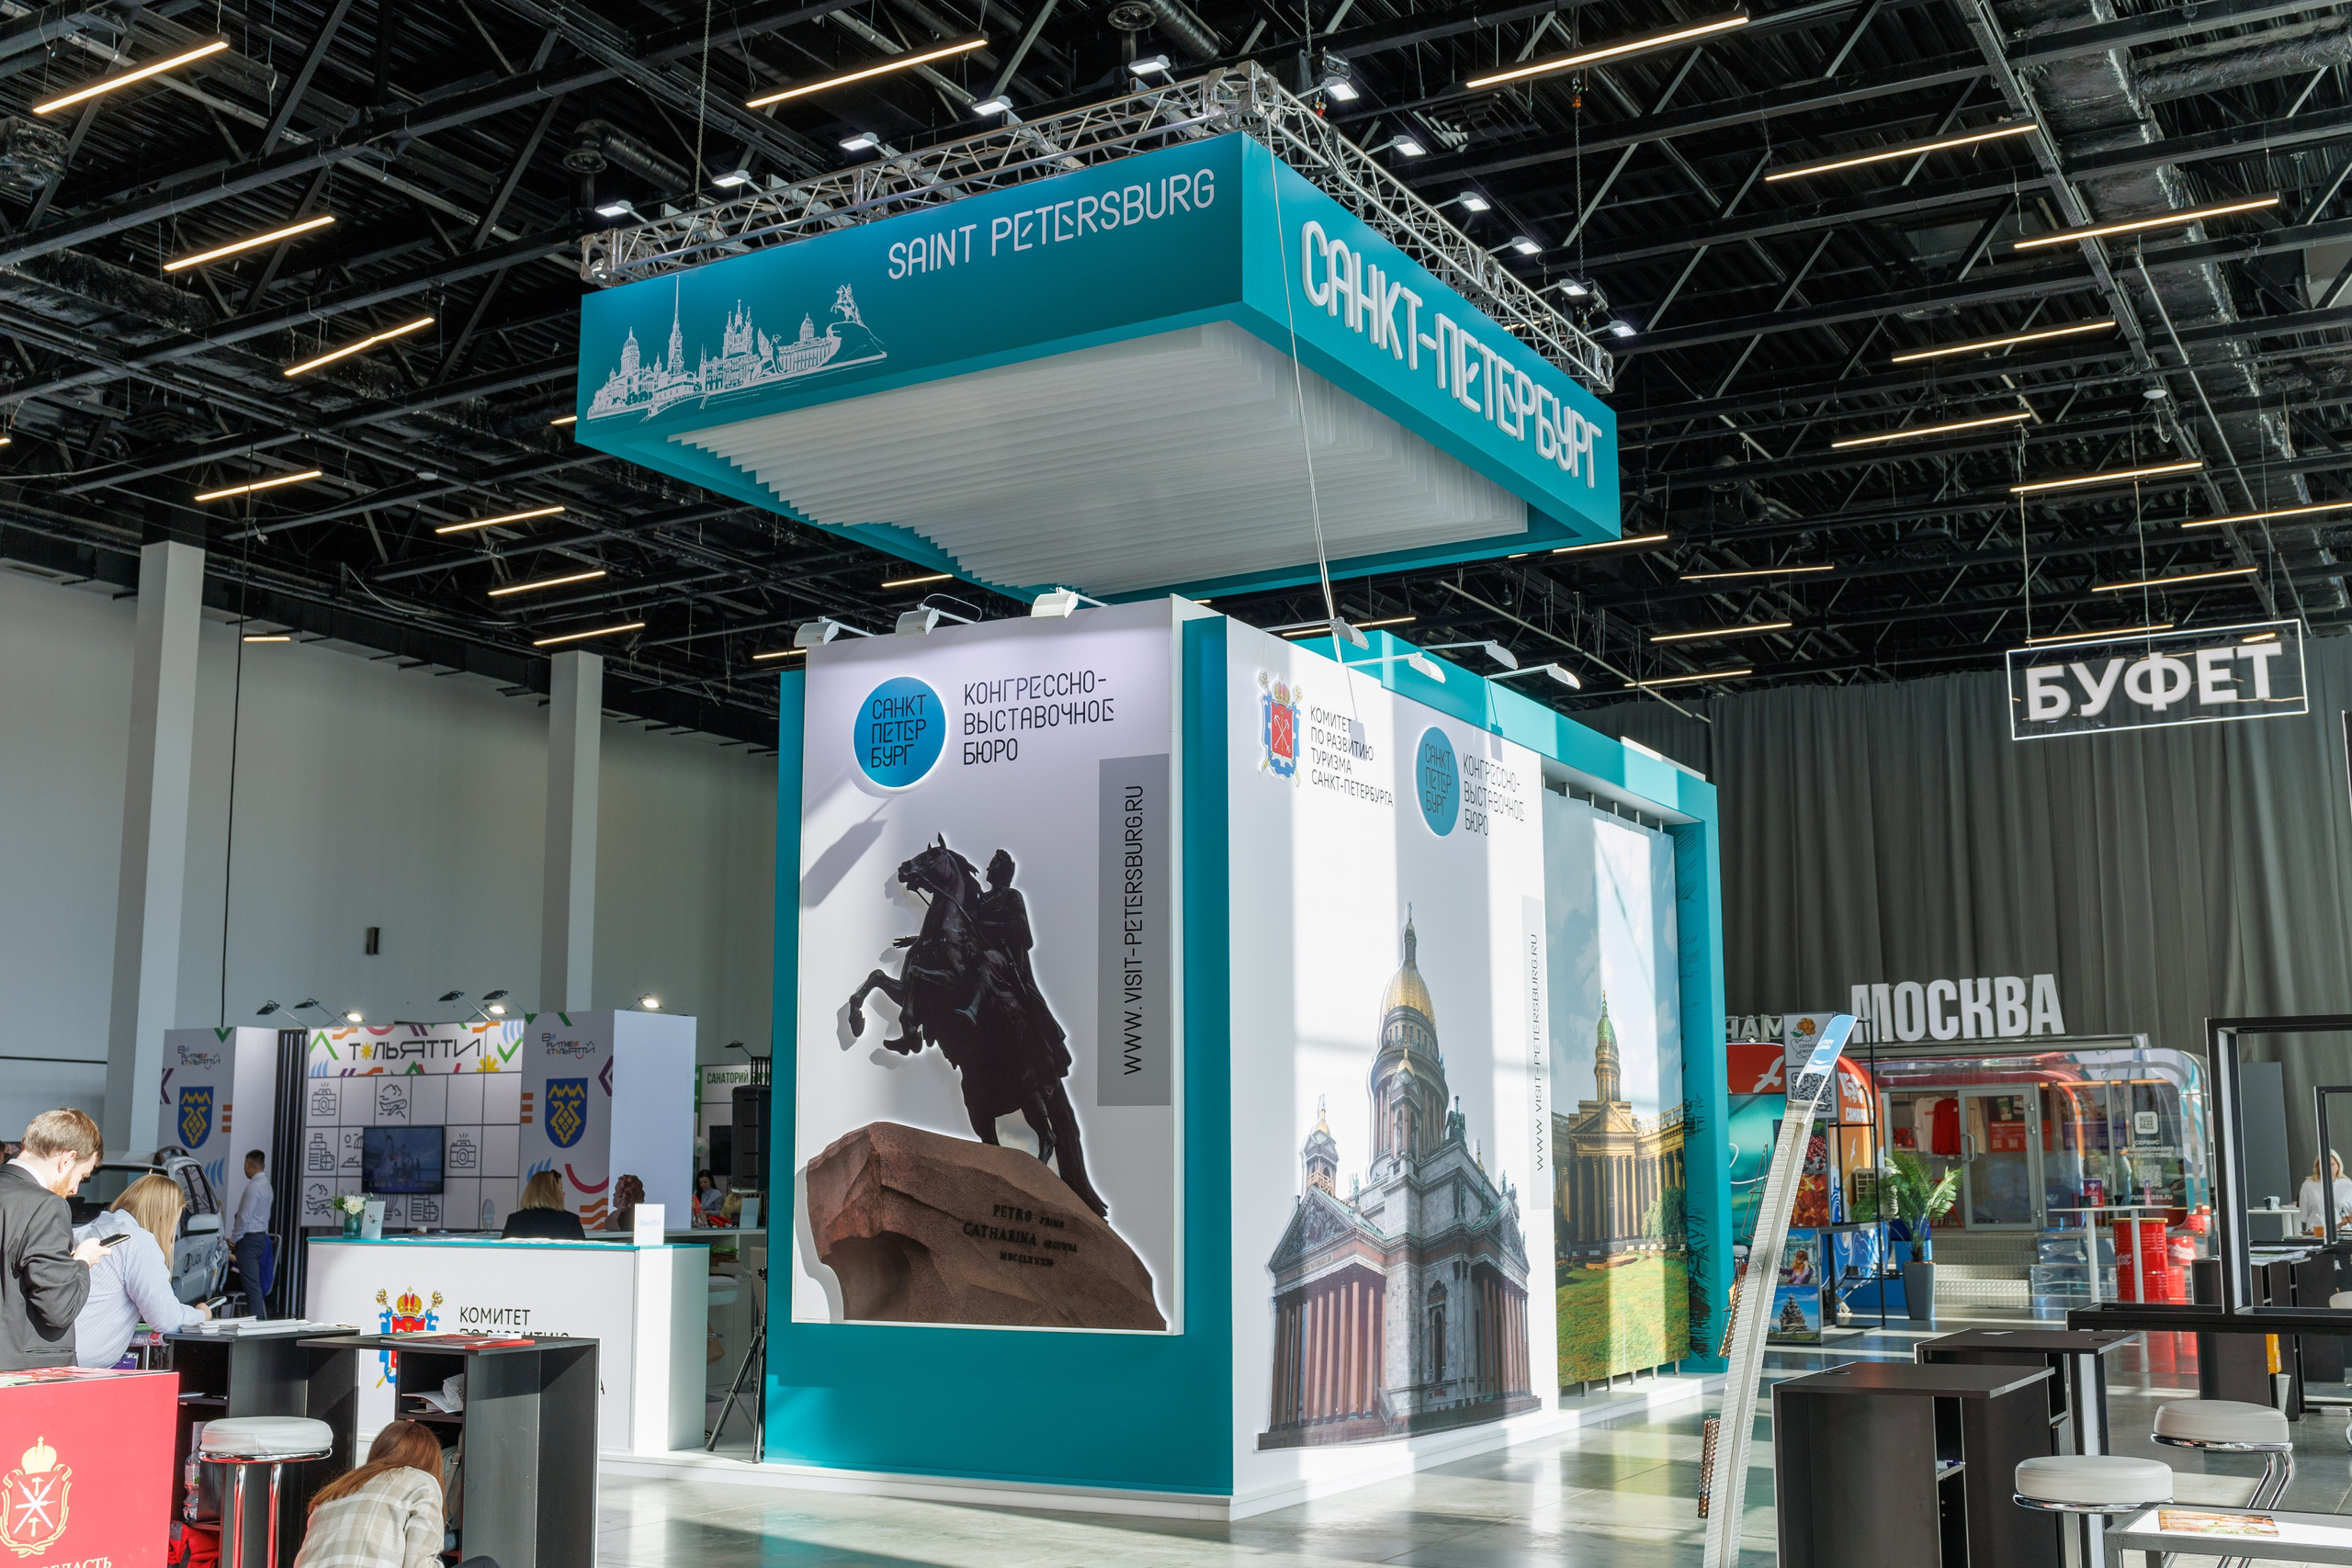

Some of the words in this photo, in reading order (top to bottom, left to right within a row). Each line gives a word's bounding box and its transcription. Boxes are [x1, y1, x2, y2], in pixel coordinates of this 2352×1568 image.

[888, 223, 977, 280] SAINT
[991, 168, 1215, 256] PETERSBURG
[1301, 220, 1602, 489] САНКТ-ПЕТЕРБУРГ
[964, 670, 1107, 706] КОНГРЕССНО-
[2026, 642, 2282, 721] БУФЕТ
[872, 694, 927, 720] САНКТ
[964, 698, 1114, 736] ВЫСТАВОЧНОЕ
[1310, 705, 1351, 731] КОМИТЕТ
[872, 719, 927, 744] ПЕТЕР
[1311, 727, 1324, 745] ПО
[1327, 731, 1374, 761] РАЗВИТИЮ
[871, 744, 915, 768] БУРГ
[963, 738, 1018, 765] БЮРО
[1311, 747, 1352, 775] ТУРИЗМА
[1425, 743, 1452, 771] САНКТ
[1425, 767, 1453, 795] ПЕТЕР
[1463, 752, 1521, 793] КОНГРЕССНО-
[1311, 769, 1395, 807] САНКТ-ПЕТЕРБУРГА
[1464, 781, 1525, 822] ВЫСТАВОЧНОЕ
[1426, 791, 1448, 817] БУРГ
[1464, 808, 1489, 837] БЮРО
[1125, 785, 1144, 1076] WWW.VISIT-PETERSBURG.RU
[1850, 973, 2065, 1044] МОСКВА
[1531, 933, 1544, 1171] WWW.VISIT-PETERSBURG.RU
[707, 1070, 749, 1085] САНАТОРИЙ
[993, 1203, 1033, 1223] PETRO
[963, 1222, 1037, 1246] CATHARINA
[459, 1306, 531, 1325] КОМИТЕТ
[41, 1556, 112, 1568] АСТЬ
